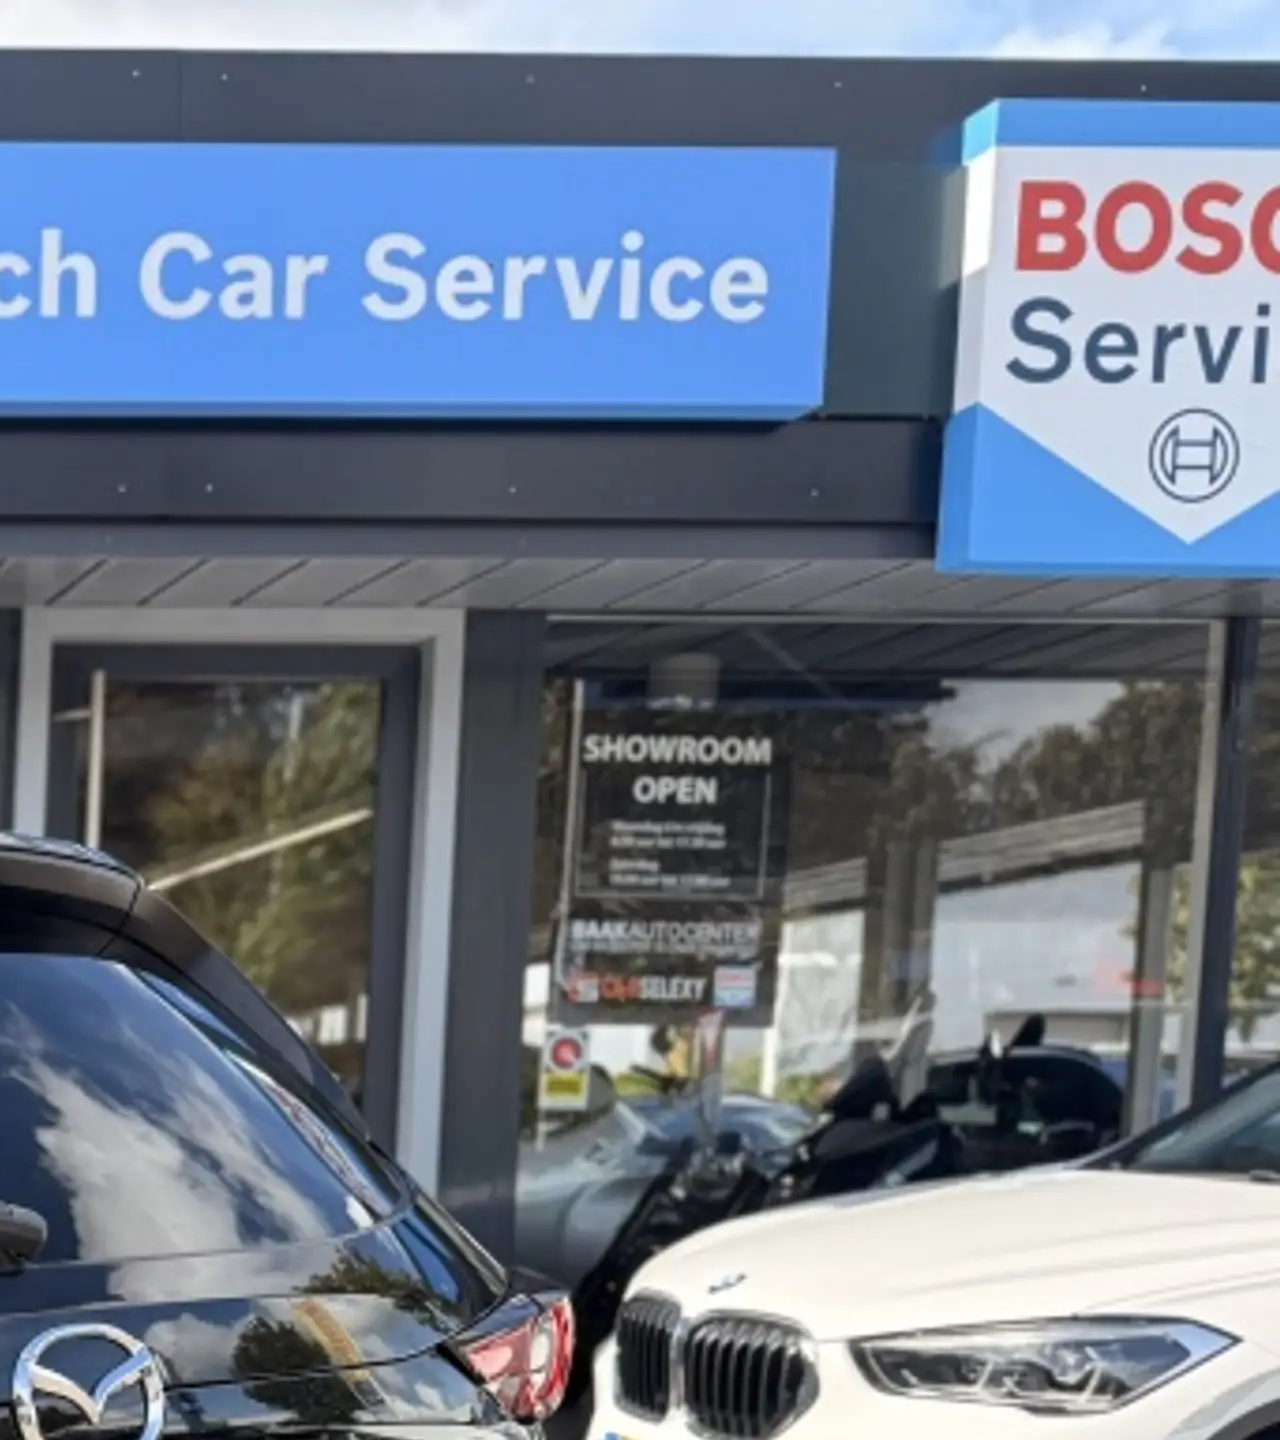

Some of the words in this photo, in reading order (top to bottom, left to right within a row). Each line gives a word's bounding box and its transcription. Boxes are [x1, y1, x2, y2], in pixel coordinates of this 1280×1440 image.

[137, 230, 329, 321] Car
[360, 230, 770, 324] Service
[1005, 296, 1272, 384] Servi
[582, 733, 773, 766] SHOWROOM
[632, 775, 718, 804] OPEN
